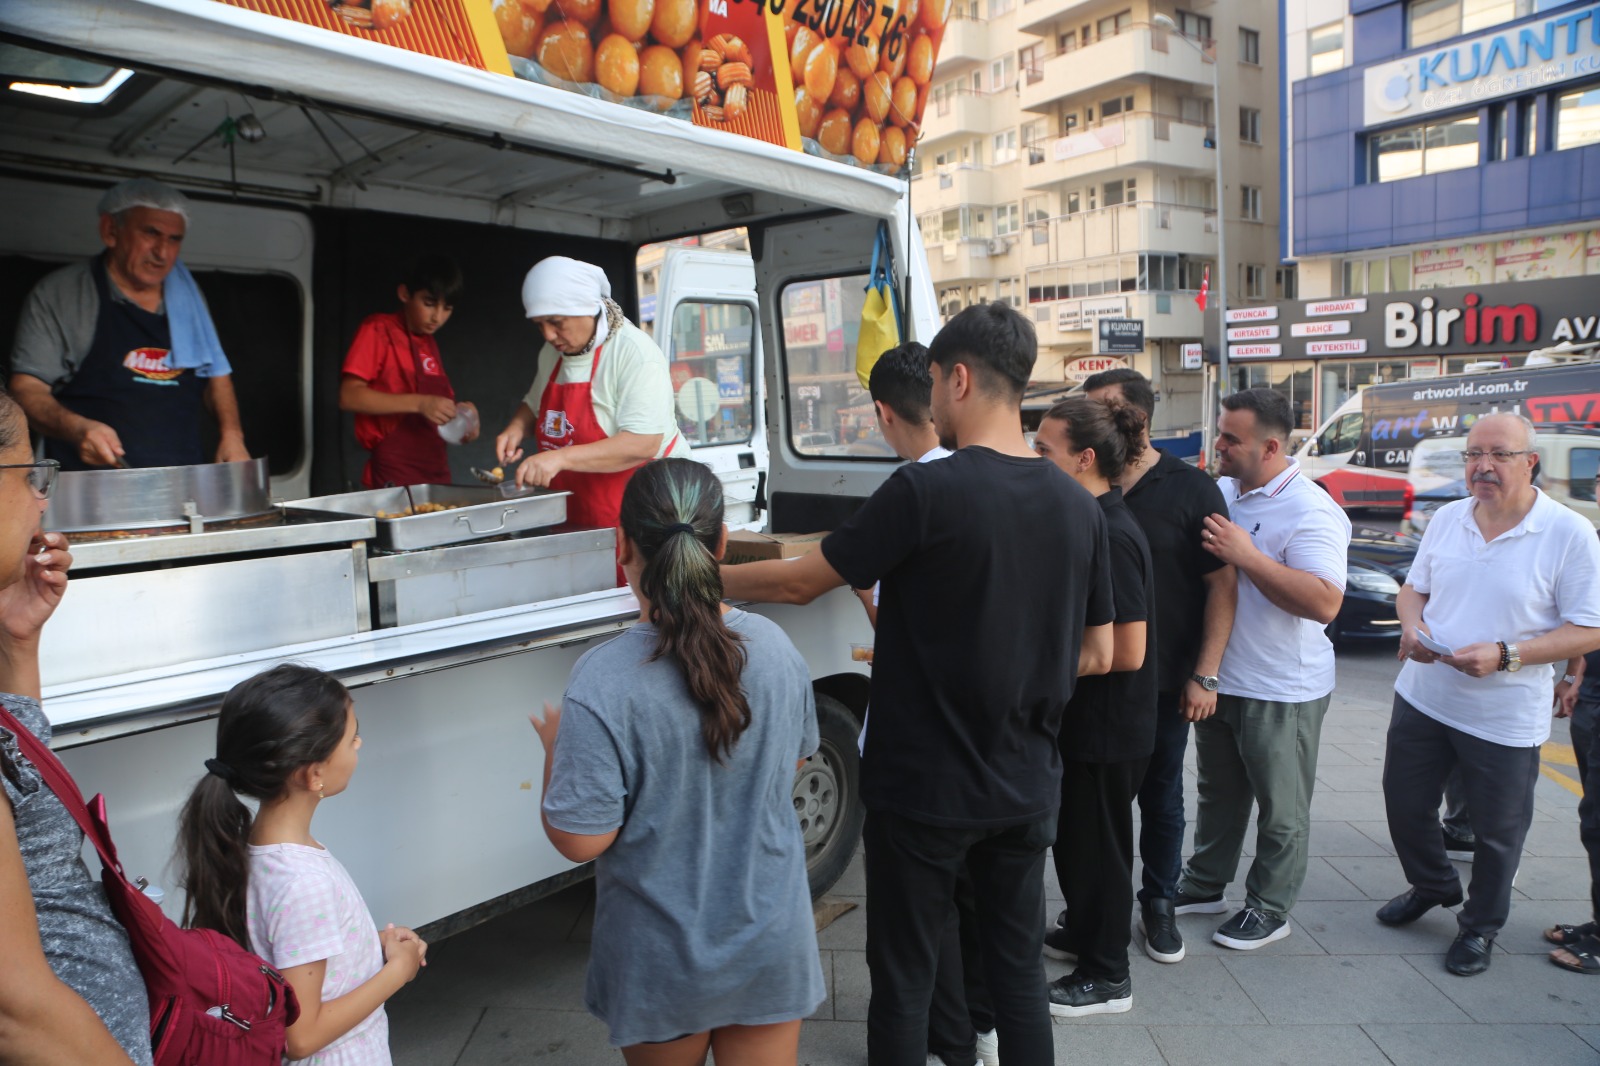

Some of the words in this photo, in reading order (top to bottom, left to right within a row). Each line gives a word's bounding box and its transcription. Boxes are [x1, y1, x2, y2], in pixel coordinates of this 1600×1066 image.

[1315, 302, 1356, 313] HIRDAVAT
[1233, 310, 1268, 320] OYUNCAK
[1385, 292, 1538, 349] Birim
[1111, 322, 1141, 332] KUANTUM
[1306, 324, 1333, 335] BAHÇE
[1551, 316, 1600, 340] AV
[1234, 328, 1271, 338] KIRTASİYE
[1236, 345, 1272, 355] ELEKTRİK
[1311, 344, 1323, 353] EV
[1323, 340, 1361, 352] TEKSTİLİ
[1079, 359, 1113, 371] KENT
[1412, 379, 1529, 401] artworld.com.tr
[1371, 409, 1429, 441] art
